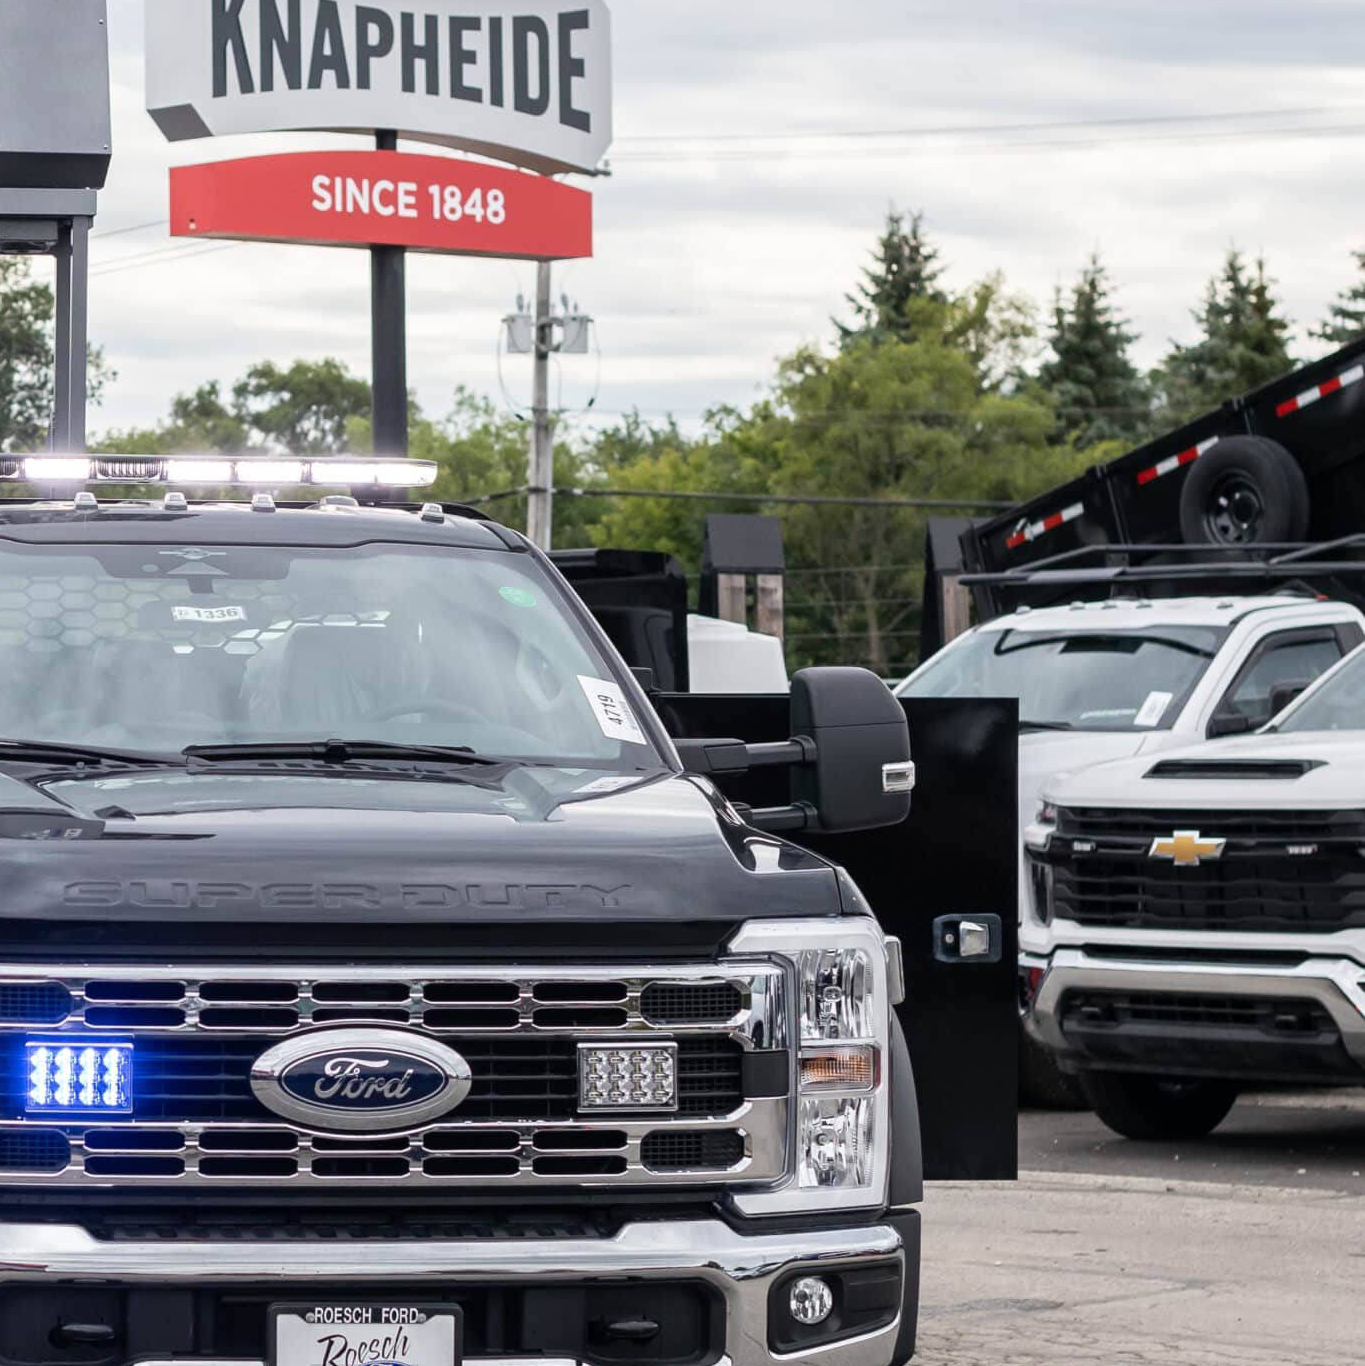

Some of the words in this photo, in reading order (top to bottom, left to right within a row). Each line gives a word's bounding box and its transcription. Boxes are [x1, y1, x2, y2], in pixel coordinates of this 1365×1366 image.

[311, 174, 418, 219] SINCE
[428, 184, 507, 225] 1848
[194, 607, 239, 620] 1336
[596, 694, 625, 726] 4719
[62, 881, 382, 910] SUPER
[400, 883, 636, 911] DUTY
[313, 1055, 414, 1101] Ford
[314, 1307, 372, 1324] ROESCH
[381, 1307, 419, 1324] FORD
